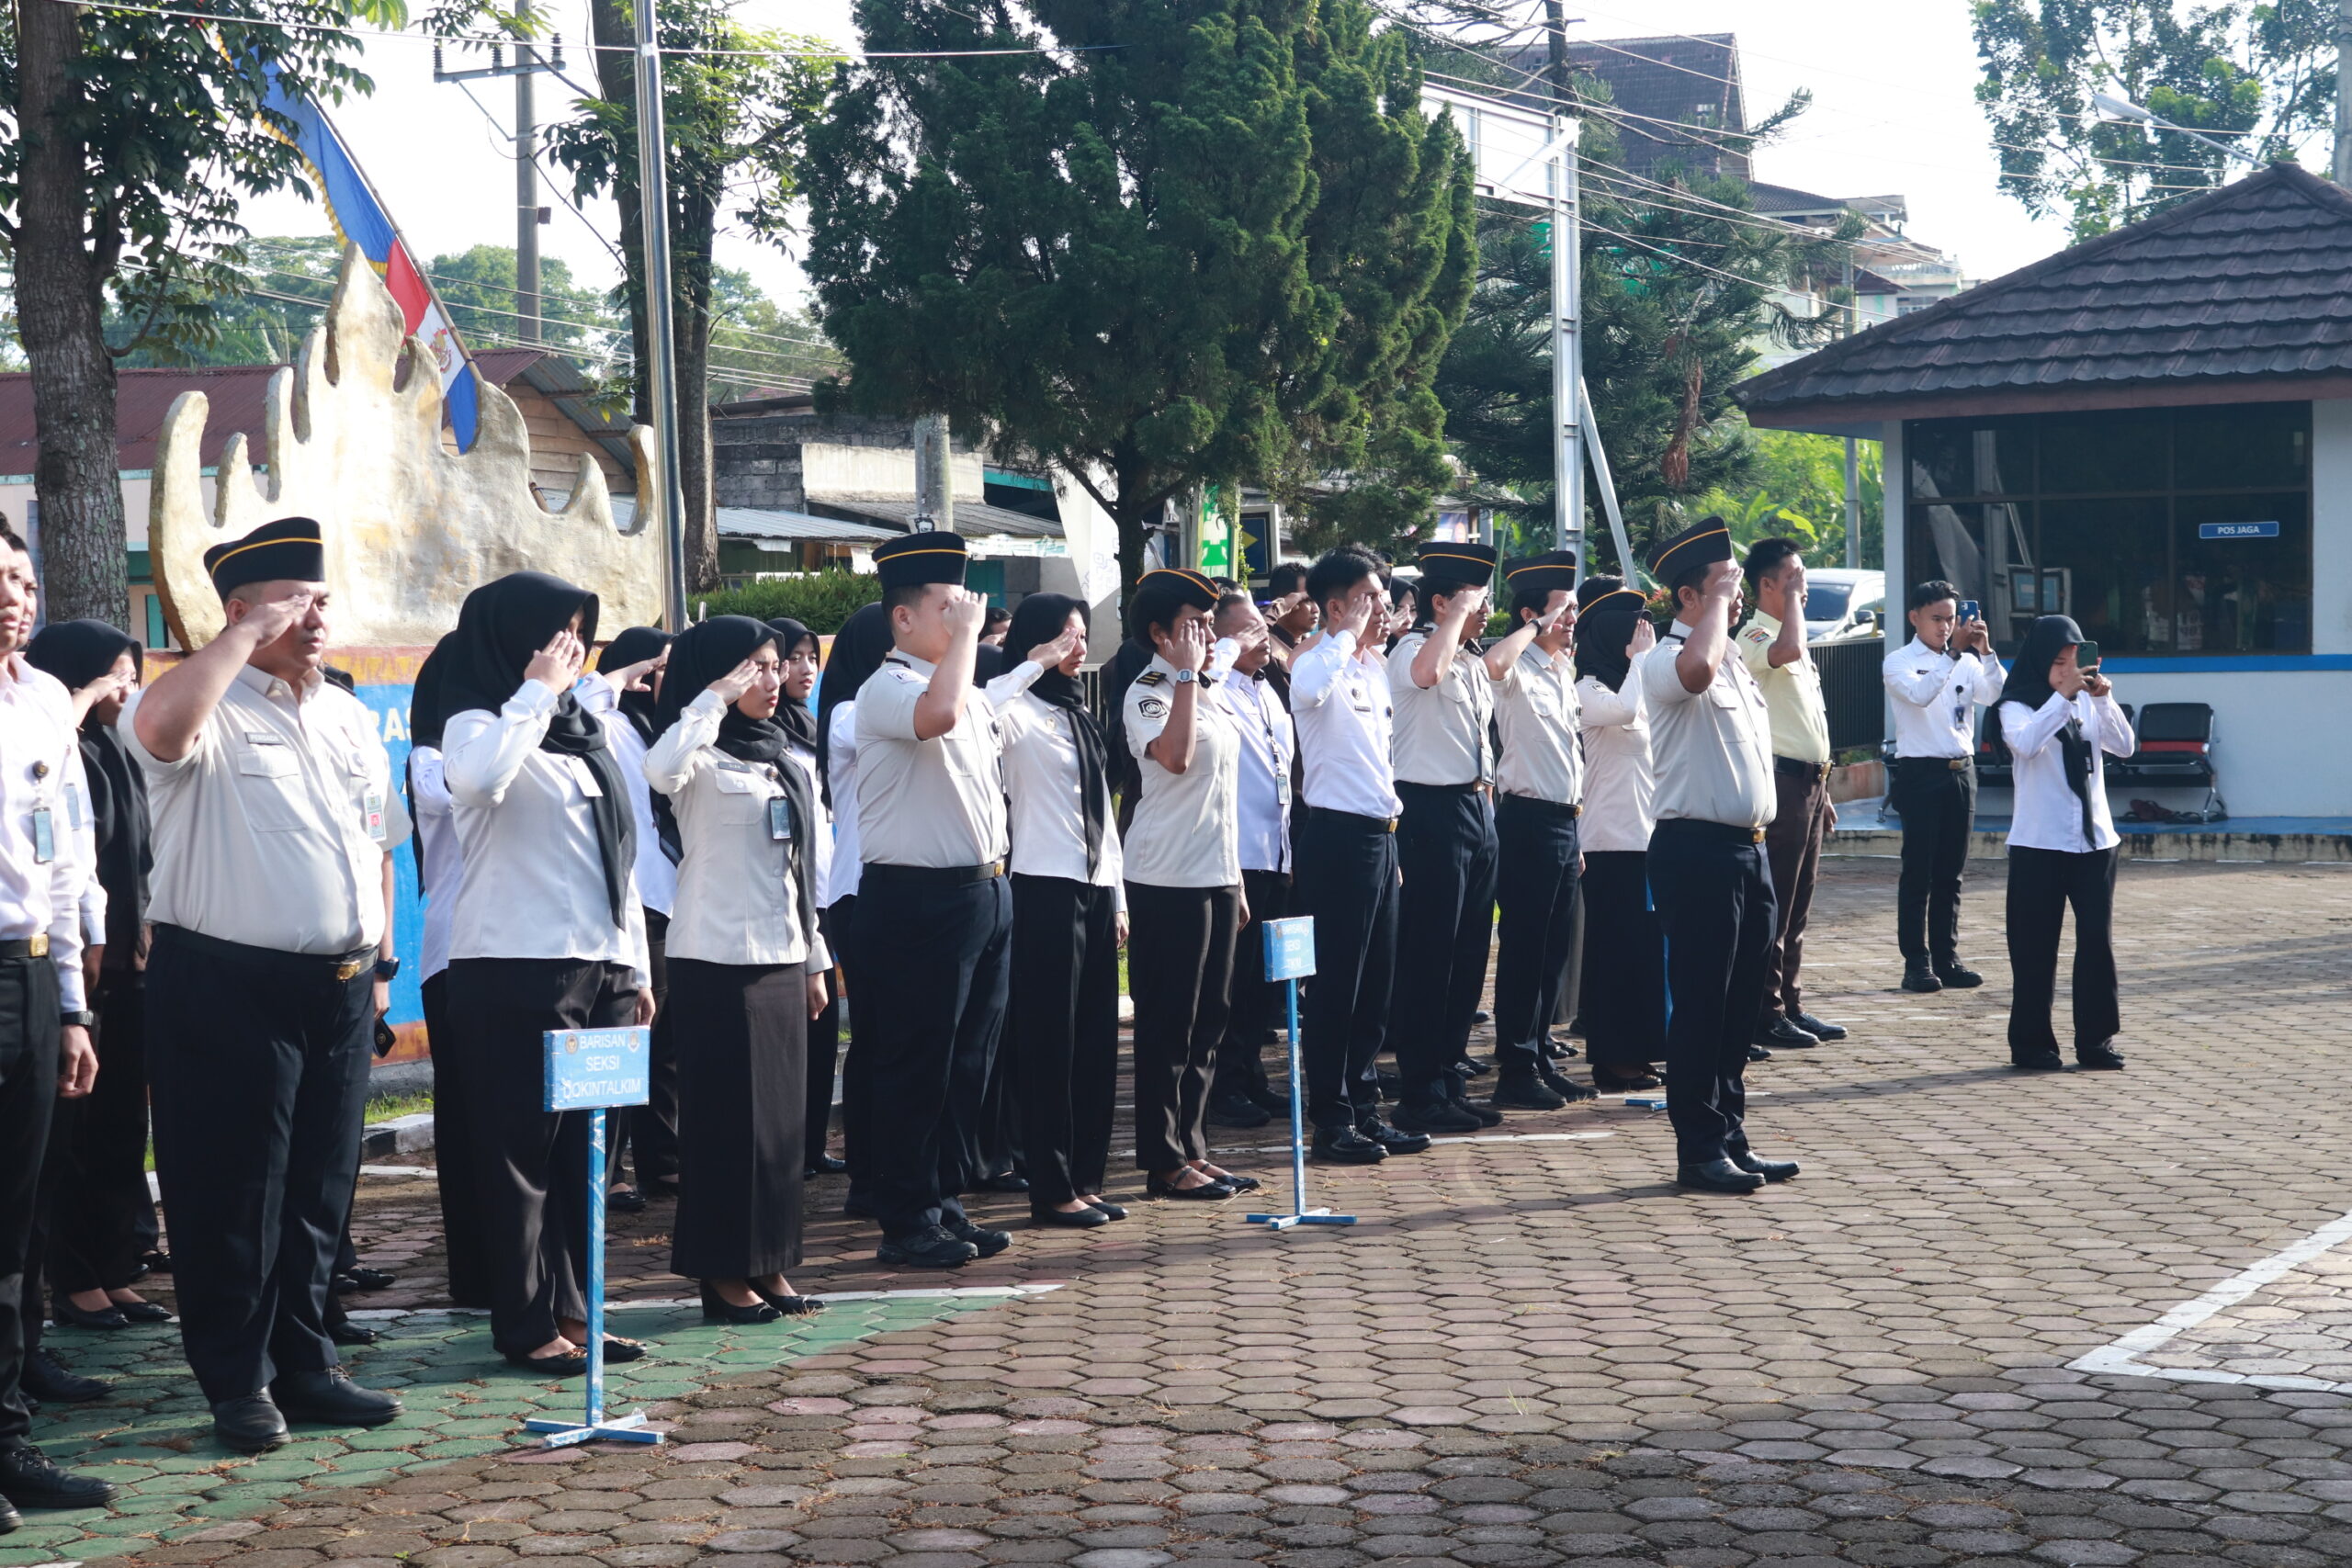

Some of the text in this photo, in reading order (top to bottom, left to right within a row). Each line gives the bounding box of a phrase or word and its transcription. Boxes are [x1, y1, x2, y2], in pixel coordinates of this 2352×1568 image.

[2218, 525, 2259, 535] POS JAGA
[580, 1034, 625, 1049] BARISAN
[586, 1055, 619, 1072] SEKSI
